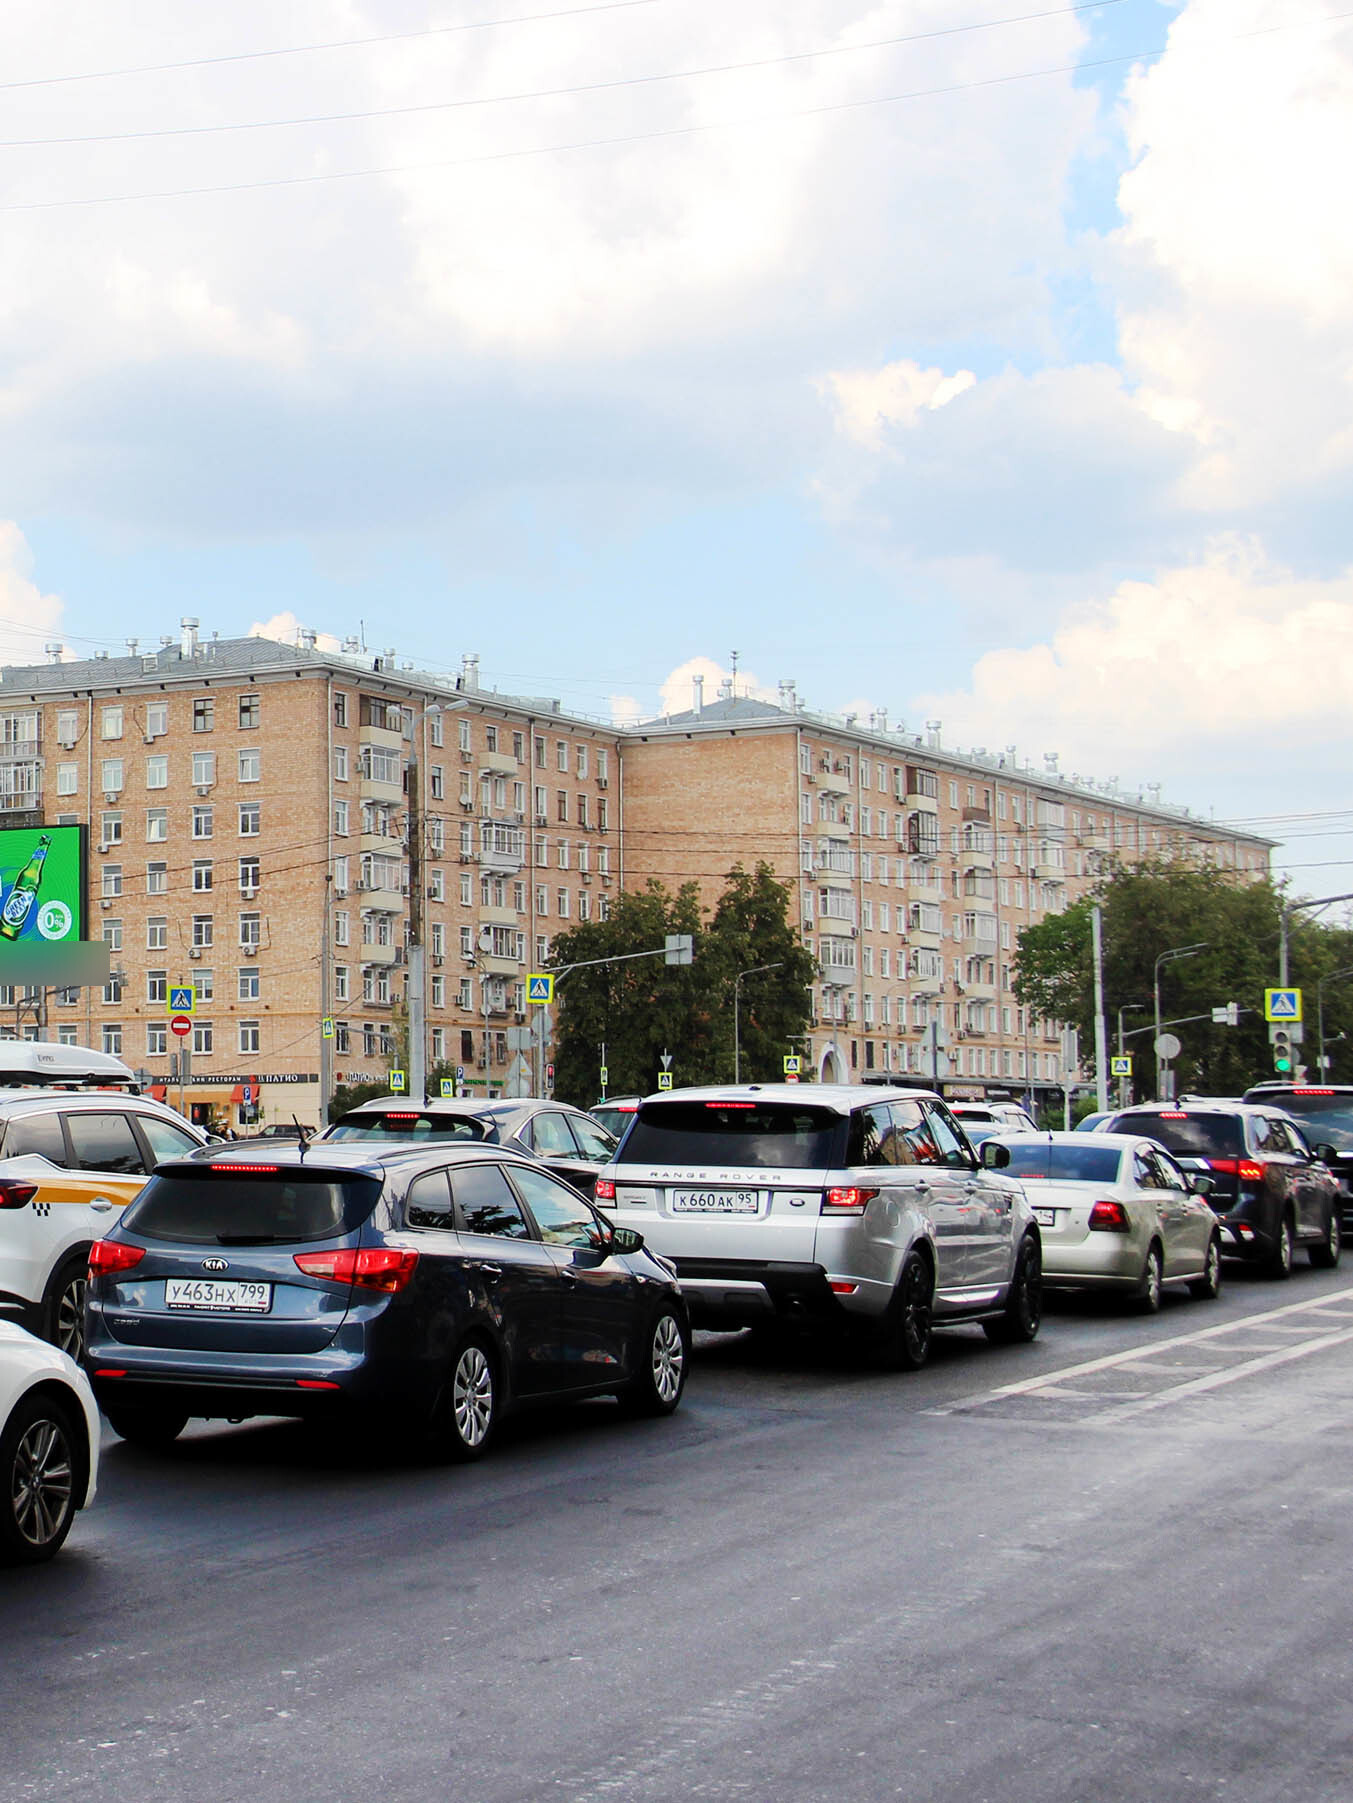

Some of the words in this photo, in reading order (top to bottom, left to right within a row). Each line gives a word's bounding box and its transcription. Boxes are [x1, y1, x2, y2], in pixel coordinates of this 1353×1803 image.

[266, 1074, 298, 1082] ПАТИО
[679, 1193, 734, 1207] К660АК
[738, 1193, 752, 1204] 95
[204, 1260, 225, 1270] KIA
[172, 1283, 237, 1303] У463НХ
[240, 1284, 265, 1299] 799
